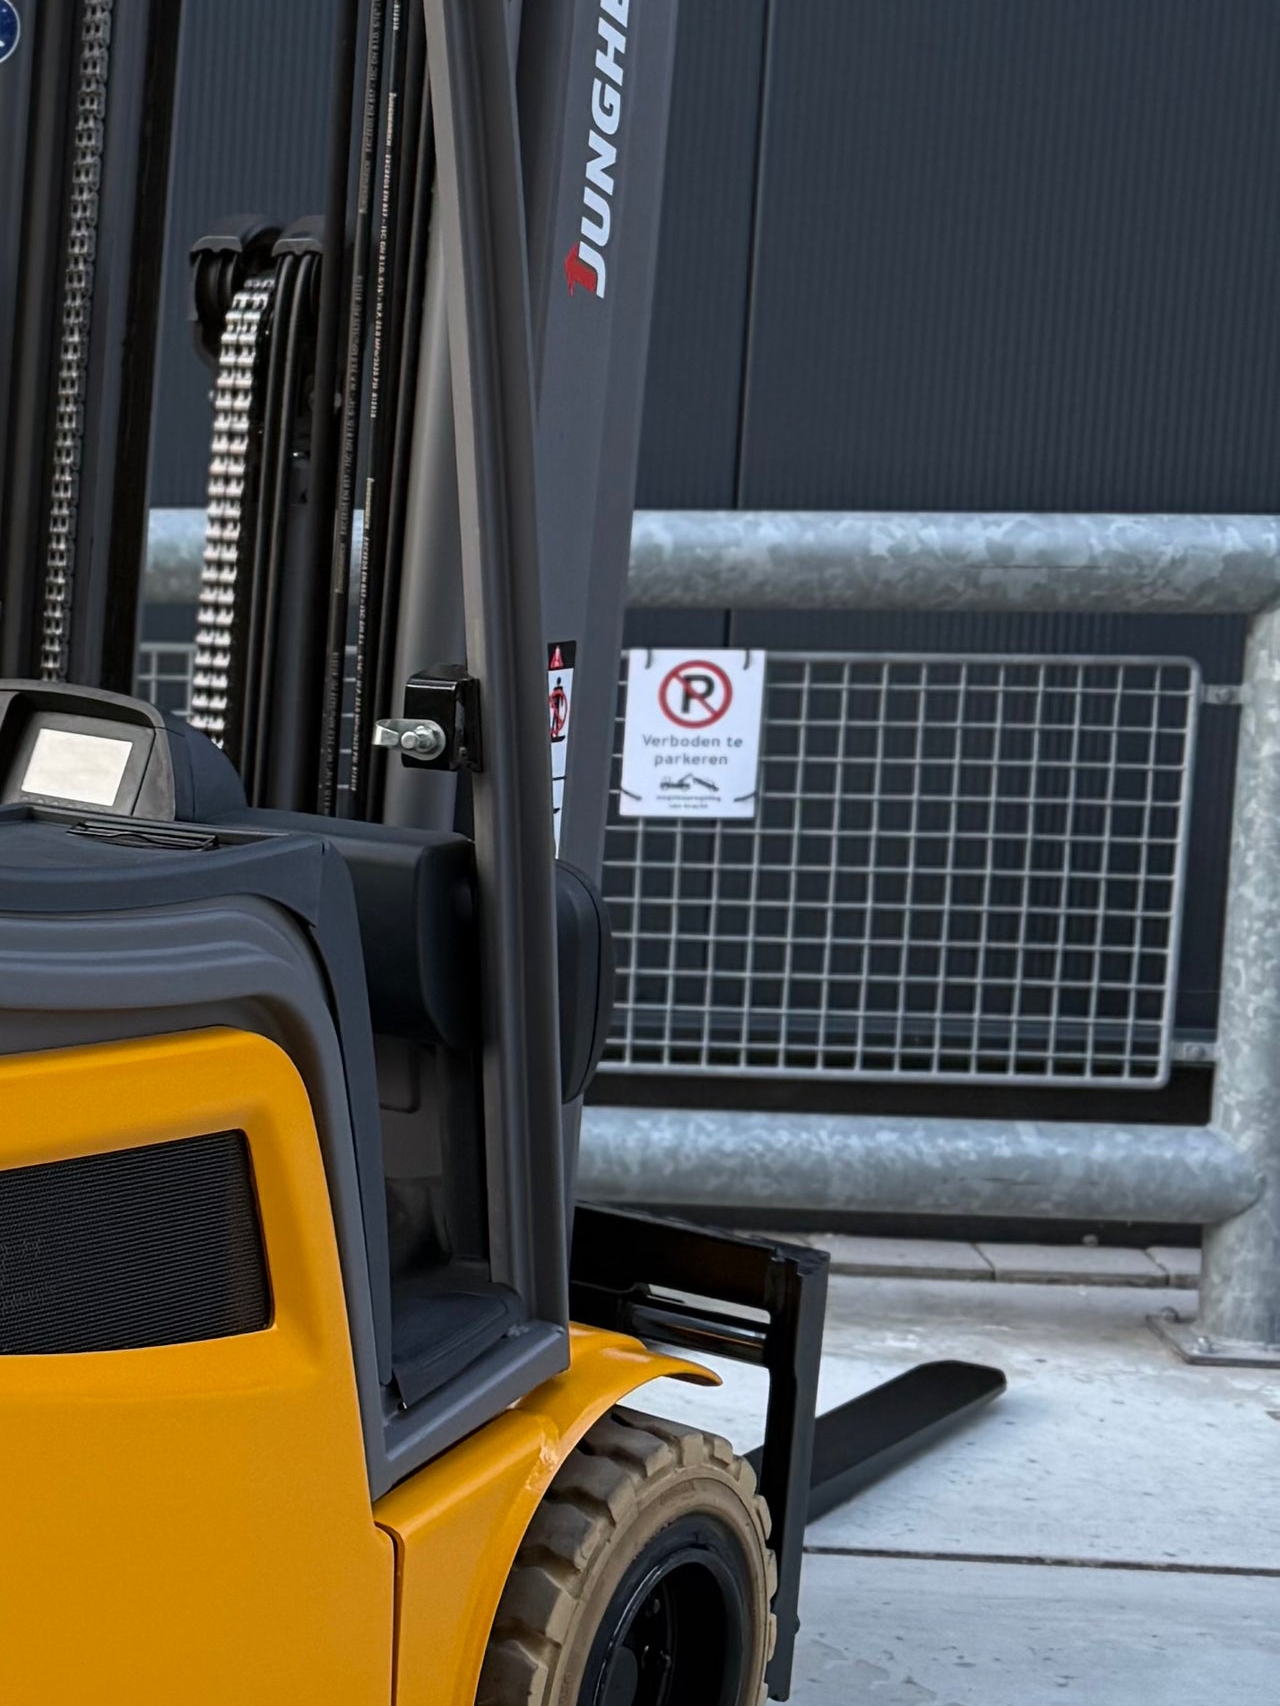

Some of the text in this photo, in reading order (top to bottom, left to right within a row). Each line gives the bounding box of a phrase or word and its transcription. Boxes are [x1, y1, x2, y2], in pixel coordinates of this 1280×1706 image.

[680, 674, 715, 714] P
[642, 734, 743, 748] Verboden te
[654, 752, 728, 767] parkeren
